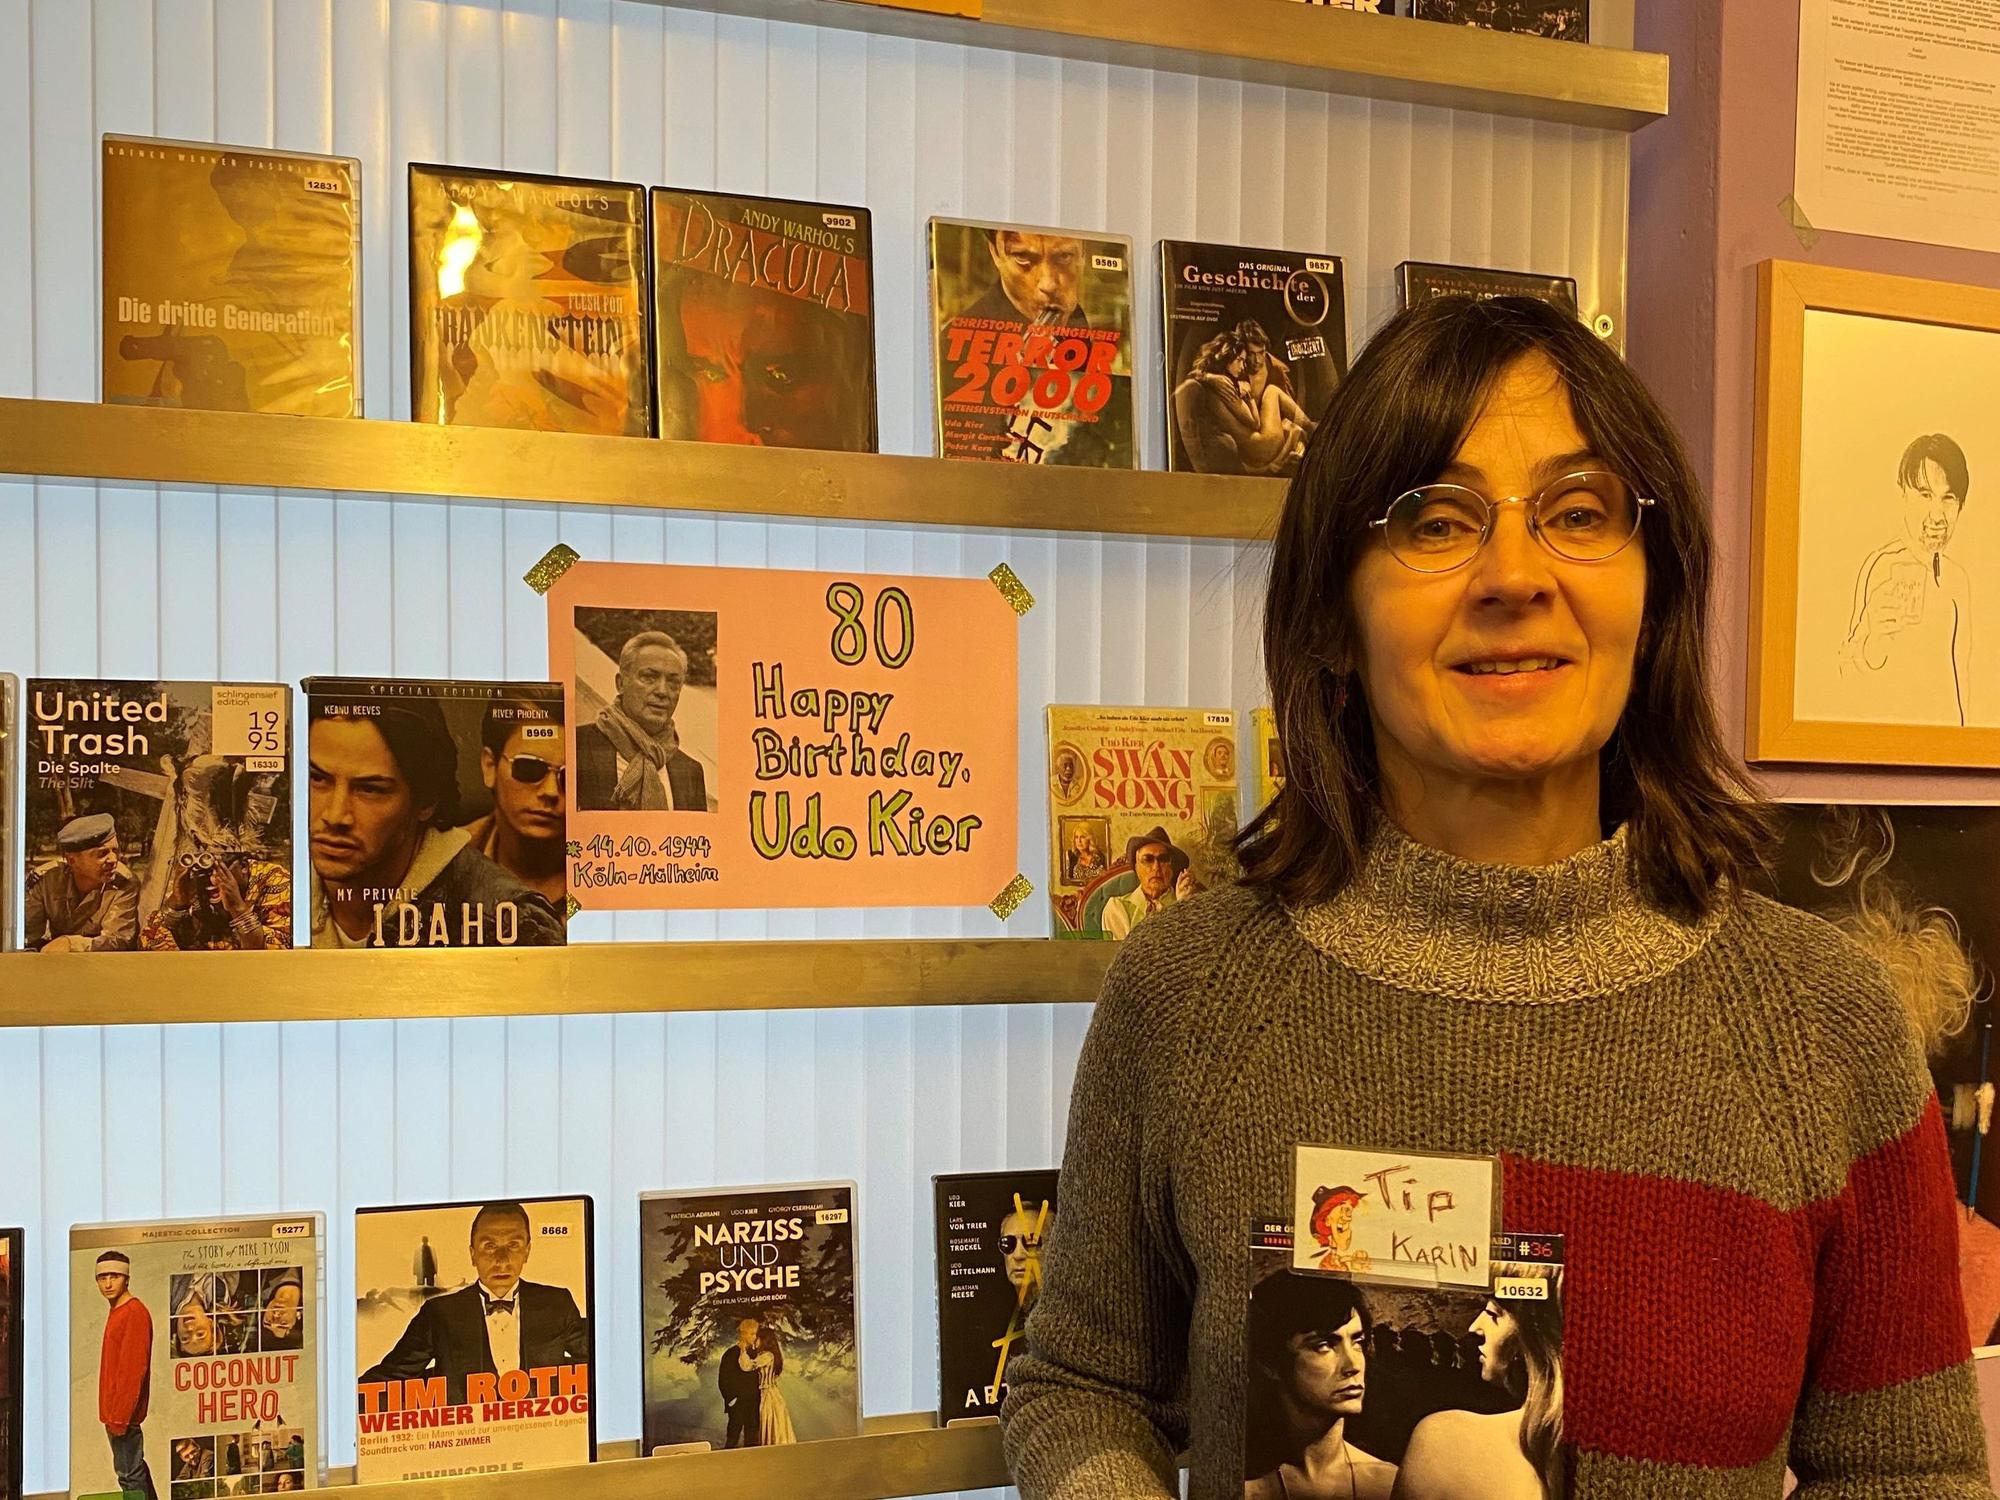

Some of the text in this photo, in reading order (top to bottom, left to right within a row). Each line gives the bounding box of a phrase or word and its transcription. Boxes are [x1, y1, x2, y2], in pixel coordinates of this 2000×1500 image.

[108, 147, 165, 160] RAINER
[178, 153, 237, 168] WERNER
[307, 181, 339, 192] 12831
[741, 208, 781, 232] ANDY
[826, 217, 851, 227] 9902
[673, 196, 851, 313] DRACULA
[1239, 261, 1291, 273] DAS ORIGINAL
[1296, 292, 1316, 302] der
[118, 297, 335, 336] Die dritte Generation
[951, 317, 1023, 333] CHRISTOPH
[946, 328, 1119, 375] TERROR
[943, 361, 1113, 414] 2000
[826, 582, 914, 669] 80
[217, 690, 279, 700] schlingensief
[370, 685, 504, 698] SPECIAL EDITION
[752, 663, 893, 734] Happy
[36, 691, 167, 722] United
[324, 705, 381, 716] KEANU REEVES
[493, 709, 549, 719] RIVER PHOENIX
[248, 711, 279, 730] 19
[38, 725, 149, 755] Trash
[248, 731, 279, 751] 95
[526, 728, 553, 738] 8969
[38, 761, 121, 776] Die Spalte
[1093, 740, 1195, 779] SWAN
[39, 777, 95, 789] The Slit
[1094, 779, 1197, 820] SONG
[749, 790, 983, 860] Udo Kier
[587, 834, 711, 858] 14.10.1944
[573, 862, 719, 889] Köln-Mülheim
[337, 888, 418, 901] MY PRIVATE
[373, 901, 518, 947] IDAHO
[731, 1208, 744, 1216] UDO
[949, 1200, 966, 1208] KIER
[142, 1226, 240, 1239] MAJESTIC COLLECTION
[276, 1225, 305, 1235] 15277
[541, 1226, 568, 1235] 8668
[694, 1218, 804, 1247] NARZISS
[1264, 1224, 1282, 1233] DER
[198, 1245, 224, 1259] STORY
[226, 1246, 238, 1258] of
[239, 1242, 258, 1256] MIKE
[263, 1241, 290, 1255] TYSON
[719, 1243, 779, 1269] UND
[950, 1244, 982, 1252] TROCKEL
[1392, 1231, 1478, 1273] KARIN
[1518, 1241, 1553, 1257] #36
[700, 1265, 800, 1295] PSYCHE
[950, 1267, 996, 1276] KITTELMANN
[951, 1291, 975, 1299] MEESE
[1501, 1286, 1543, 1297] 10632
[174, 1355, 299, 1392] COCONUT
[358, 1363, 588, 1415] TIM ROTH
[198, 1389, 280, 1424] HERO
[359, 1394, 588, 1434] WERNER HERZOG
[360, 1436, 388, 1446] Berlin
[391, 1433, 414, 1443] 1932:
[416, 1432, 429, 1441] Ein
[432, 1430, 455, 1439] Mann
[456, 1427, 475, 1436] wird
[360, 1444, 407, 1457] Soundtrack
[429, 1439, 453, 1450] HANS
[456, 1435, 491, 1447] ZIMMER
